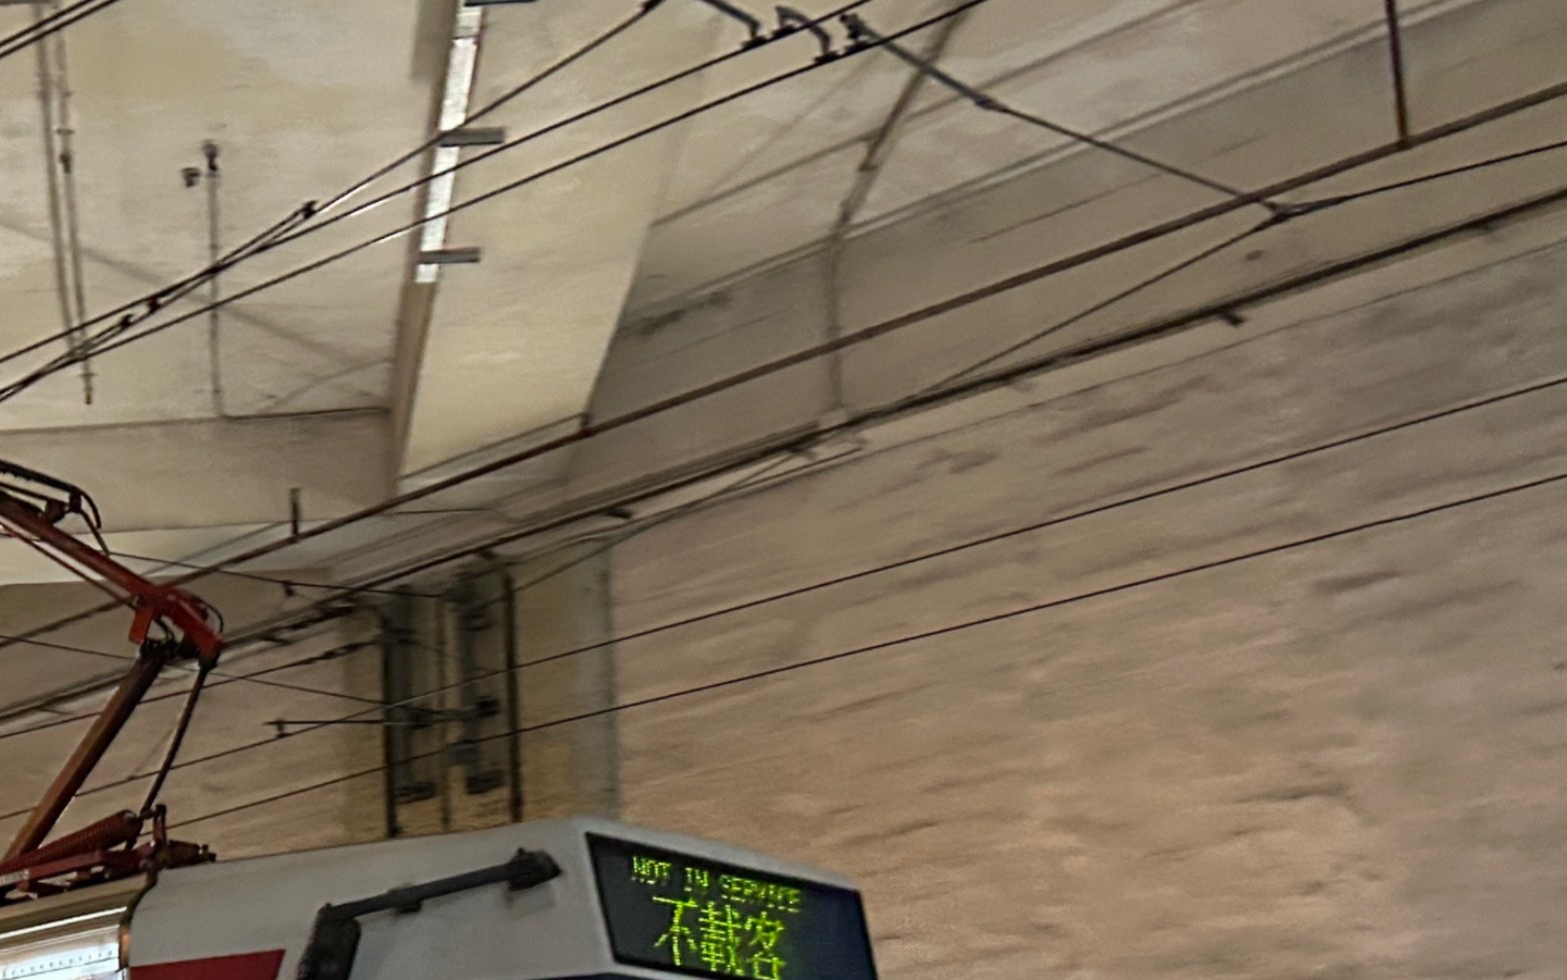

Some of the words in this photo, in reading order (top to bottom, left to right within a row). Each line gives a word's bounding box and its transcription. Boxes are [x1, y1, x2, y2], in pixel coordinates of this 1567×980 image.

[631, 856, 672, 886] NOT
[684, 867, 709, 892] IN
[718, 874, 801, 912] SERVICE
